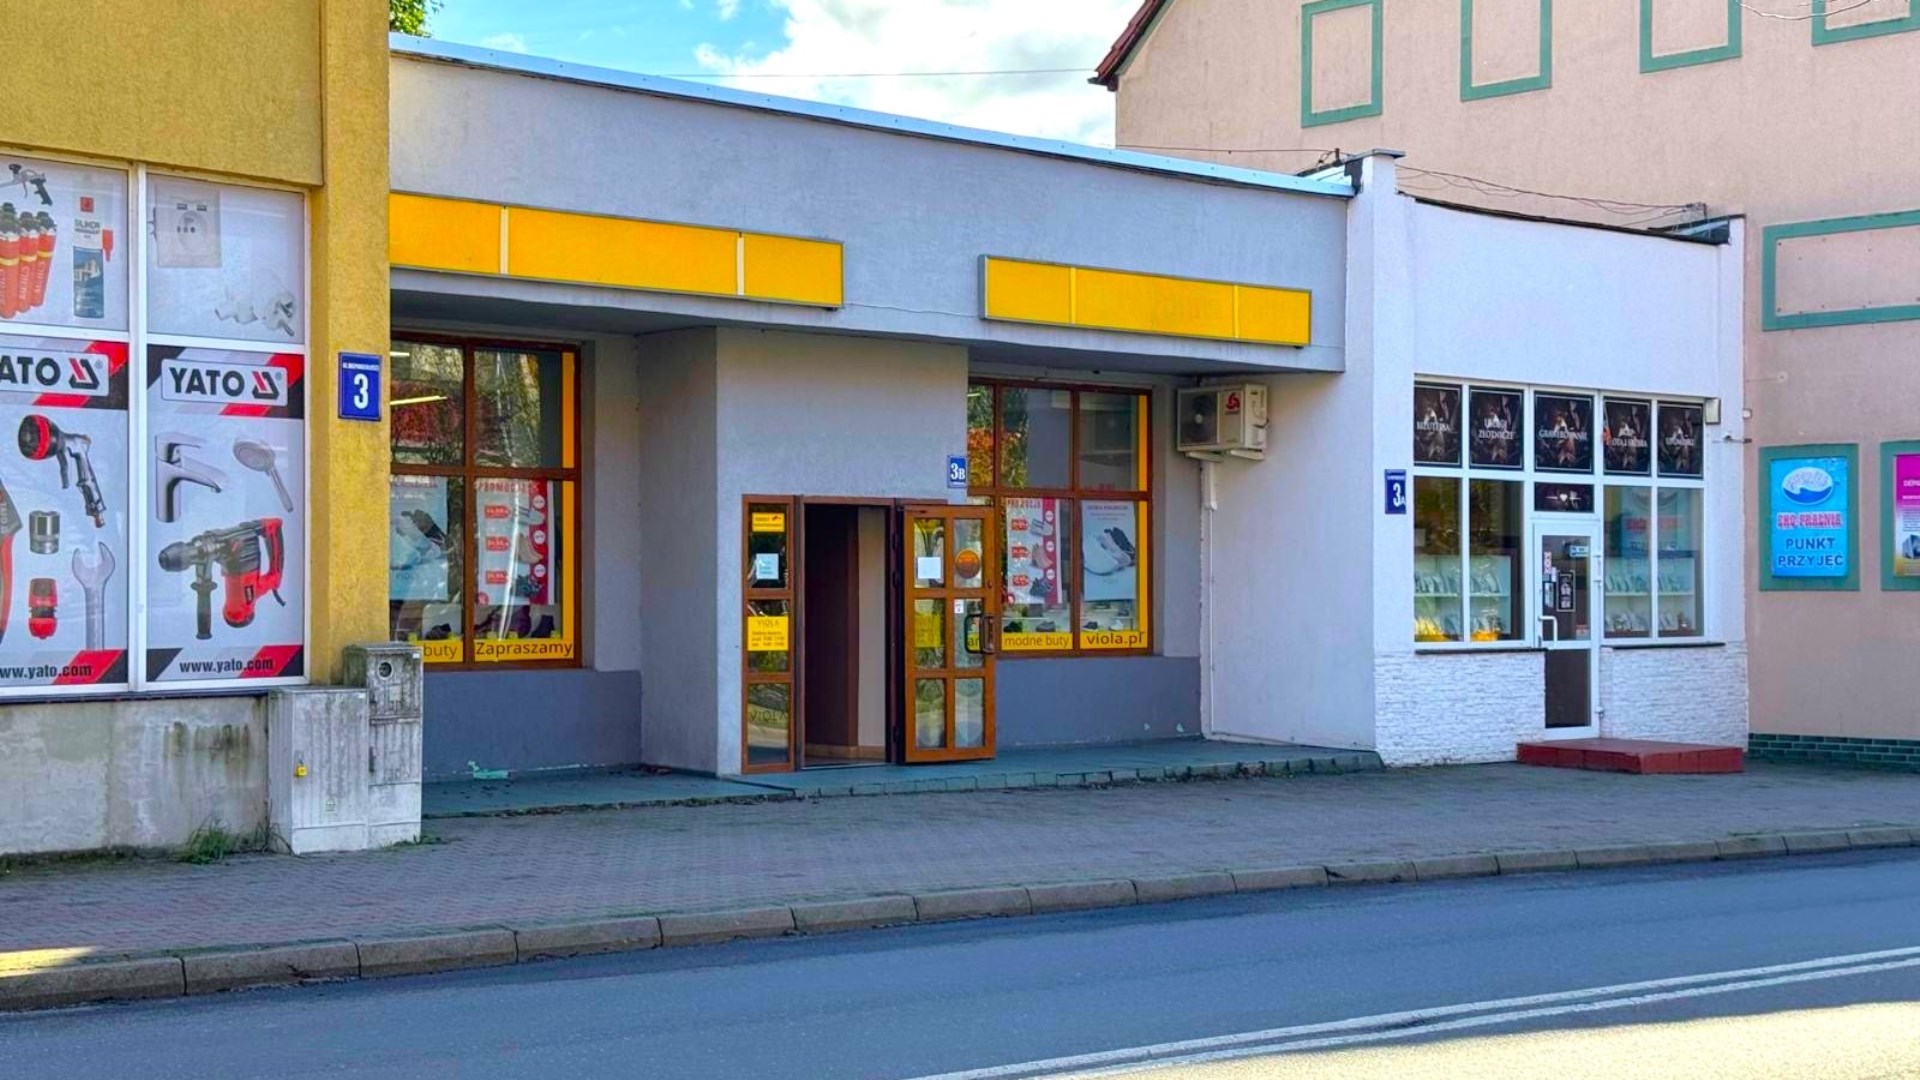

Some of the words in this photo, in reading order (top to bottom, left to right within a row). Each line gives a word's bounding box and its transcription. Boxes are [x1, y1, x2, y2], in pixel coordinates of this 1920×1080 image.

[169, 367, 245, 397] YATO
[353, 373, 369, 410] 3
[951, 462, 966, 480] 3B
[1786, 538, 1835, 550] PUNKT
[1004, 634, 1042, 647] modne
[1046, 634, 1070, 648] buty
[1086, 632, 1144, 647] viola.pl
[423, 643, 458, 658] buty
[475, 641, 573, 658] Zapraszamy
[180, 657, 273, 673] www.yato.com
